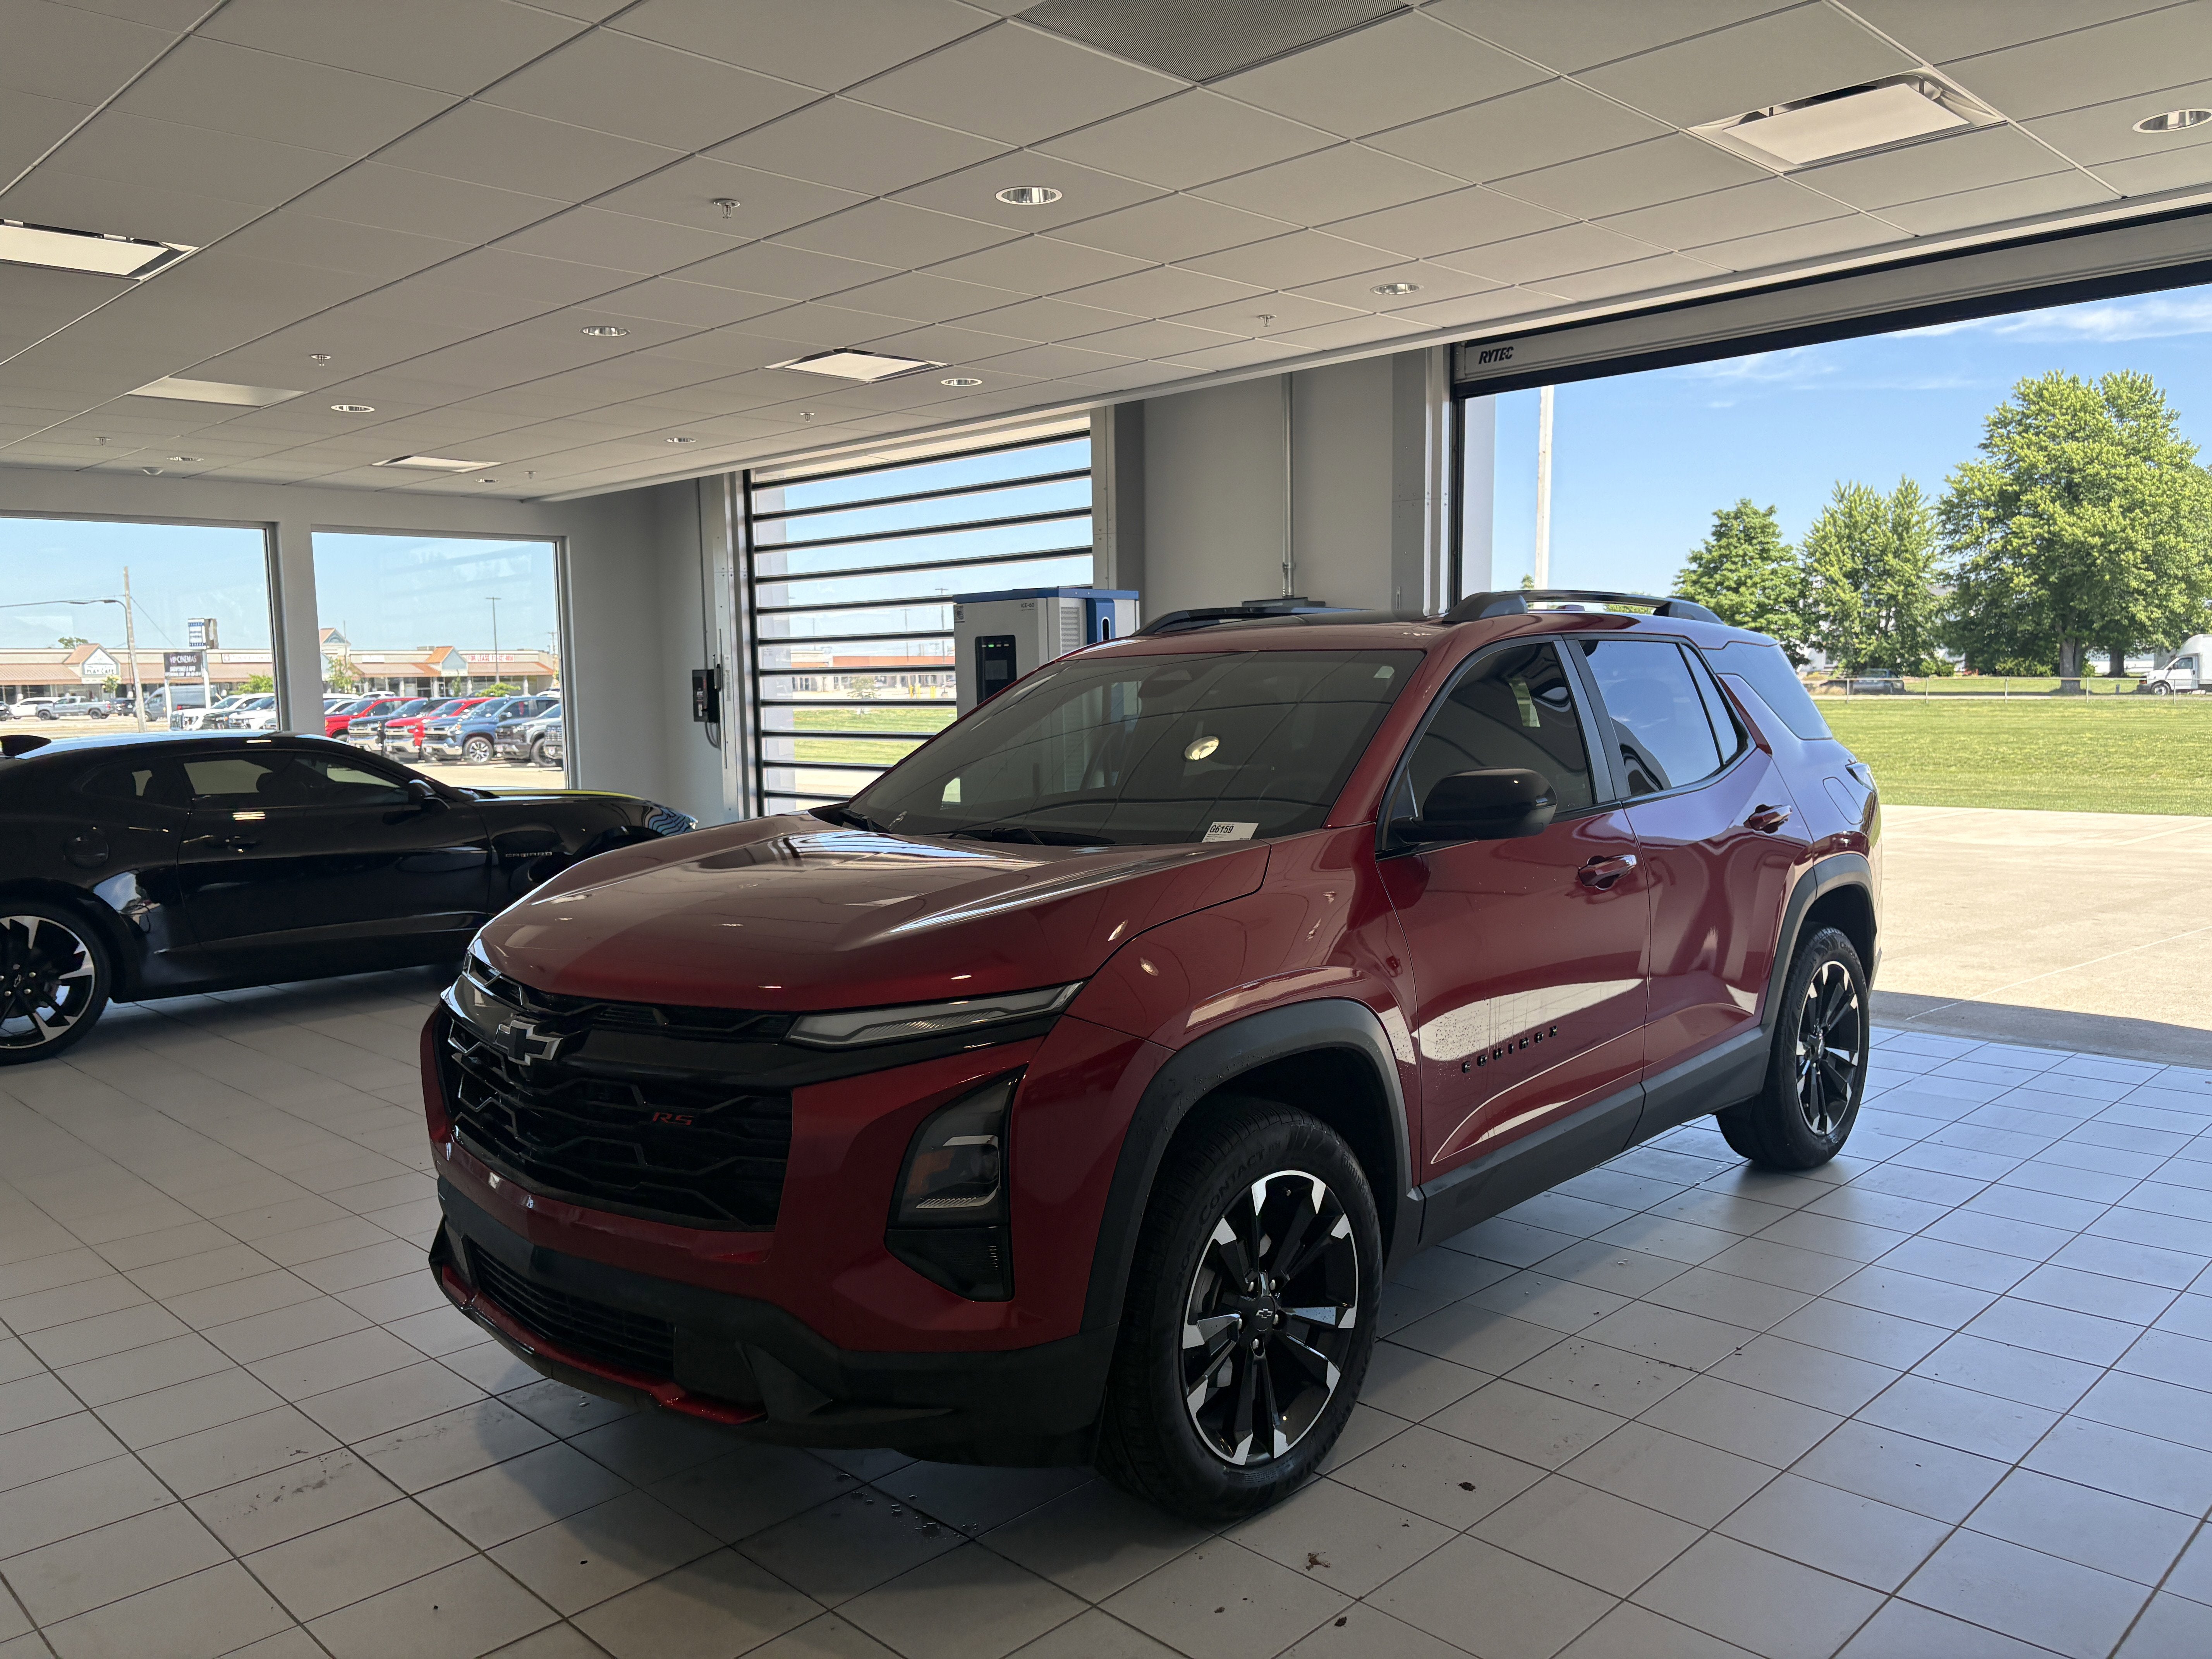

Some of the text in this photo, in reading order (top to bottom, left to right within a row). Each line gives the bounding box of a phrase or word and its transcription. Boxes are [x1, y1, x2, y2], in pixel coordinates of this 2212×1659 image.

[1479, 347, 1514, 364] RYTEC
[1209, 825, 1234, 833] G6159
[1462, 1025, 1558, 1073] EQUINOX
[653, 1112, 694, 1125] RS
